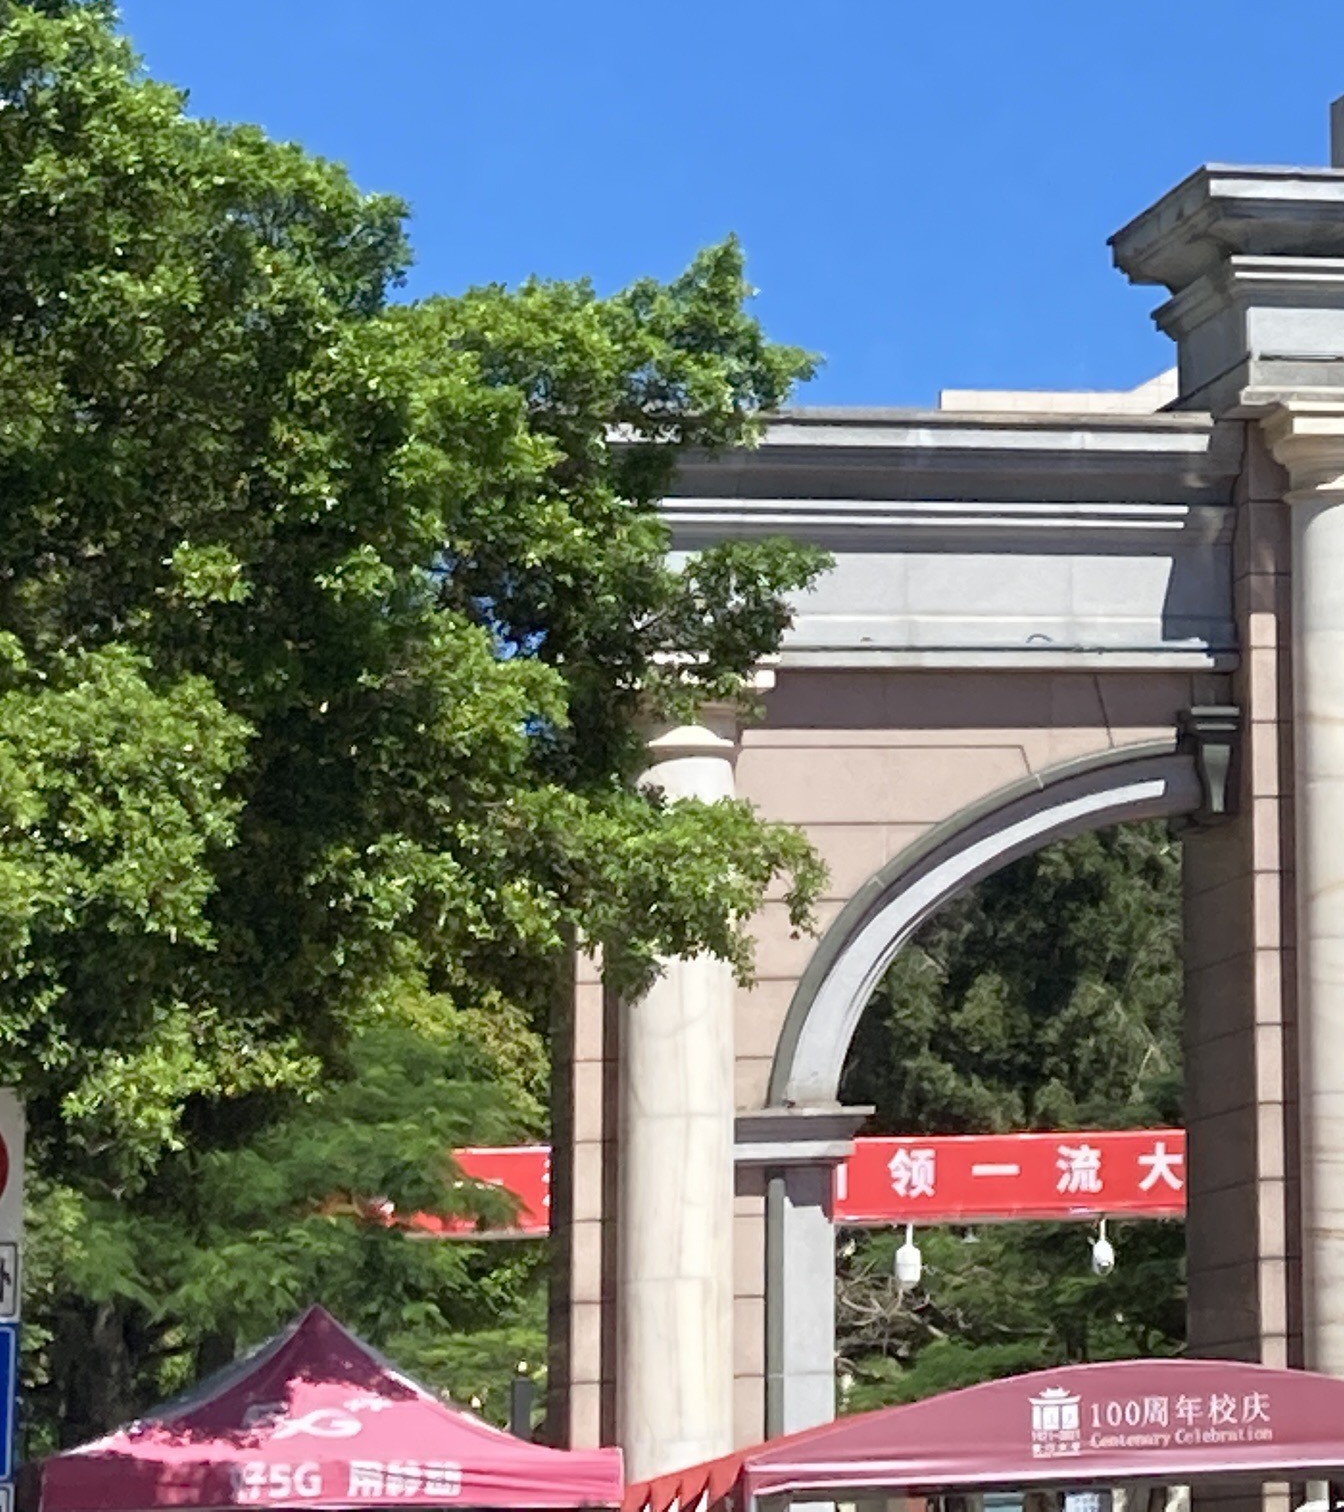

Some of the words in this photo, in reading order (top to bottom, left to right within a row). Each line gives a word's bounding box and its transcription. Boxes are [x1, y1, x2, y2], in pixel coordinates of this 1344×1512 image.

[837, 1141, 1184, 1200] 领一流大
[1089, 1391, 1271, 1428] 100周年校庆
[1175, 1426, 1273, 1445] Celebration
